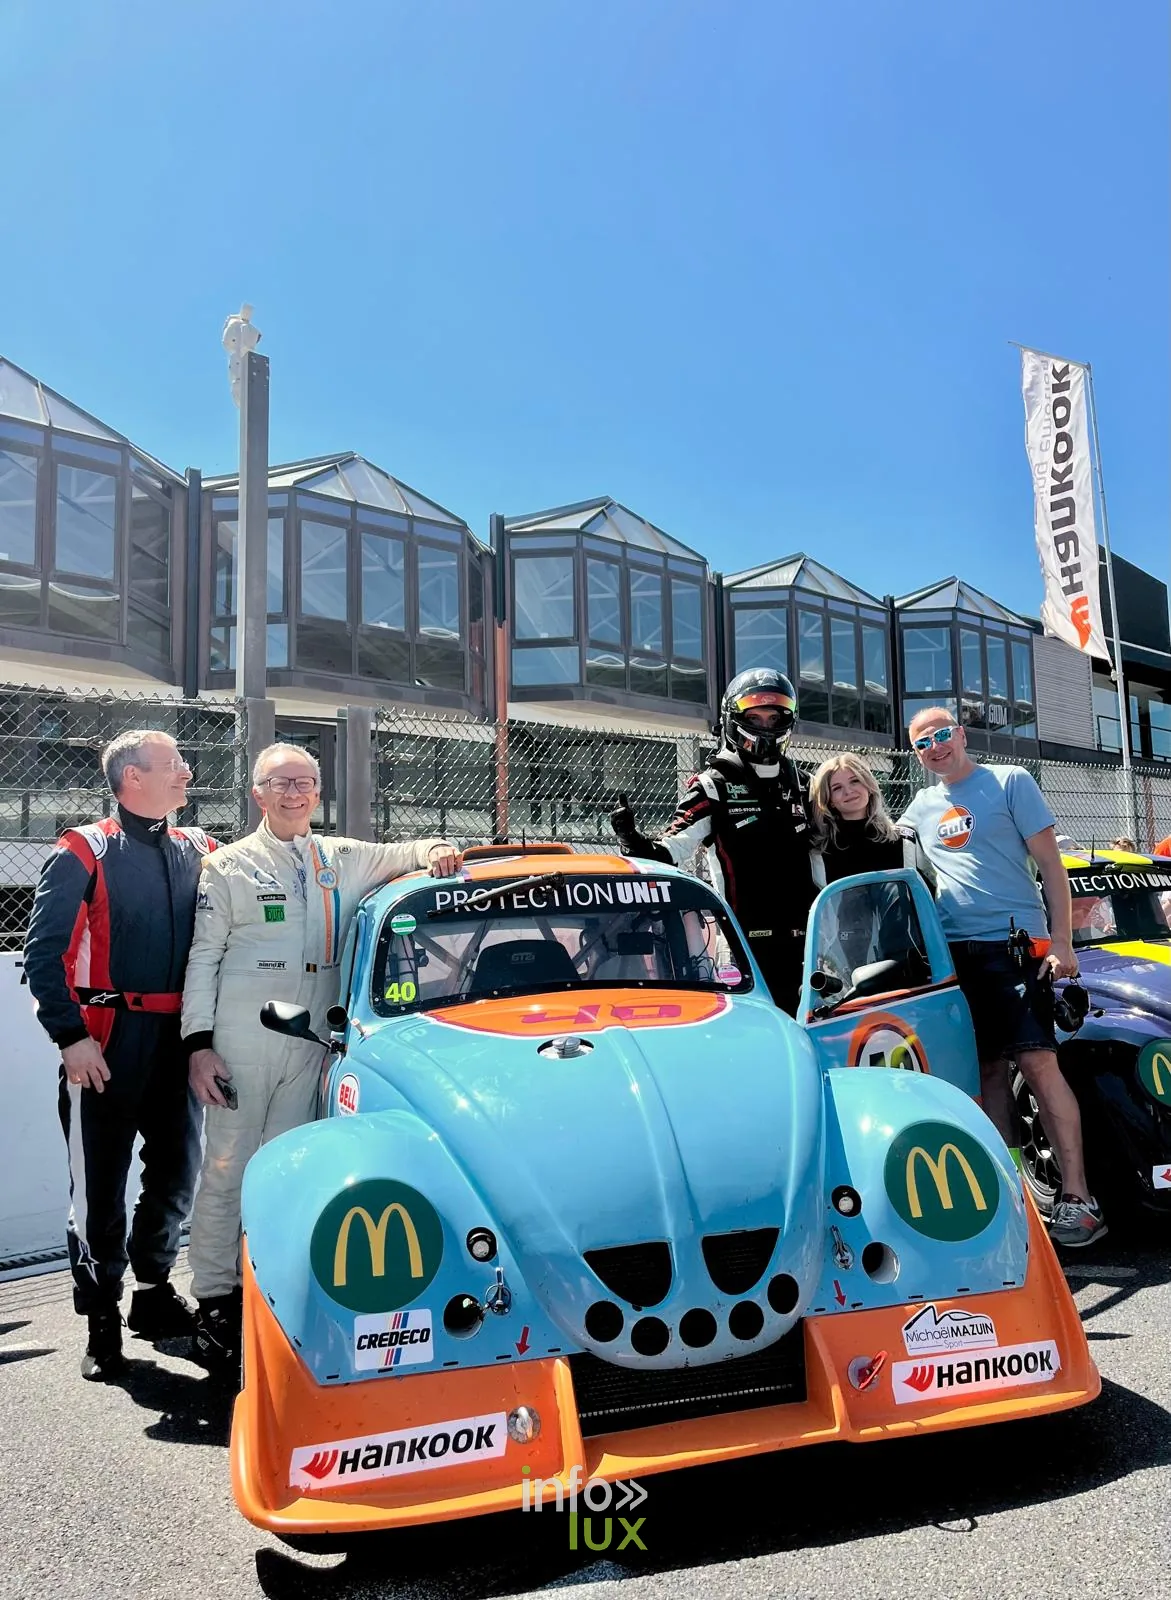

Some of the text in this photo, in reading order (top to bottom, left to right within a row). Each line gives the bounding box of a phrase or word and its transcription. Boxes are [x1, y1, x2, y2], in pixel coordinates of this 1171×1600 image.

[937, 817, 972, 837] Gulf
[385, 981, 416, 1003] 40
[339, 1083, 356, 1111] BELL
[356, 1328, 431, 1351] CREDECO
